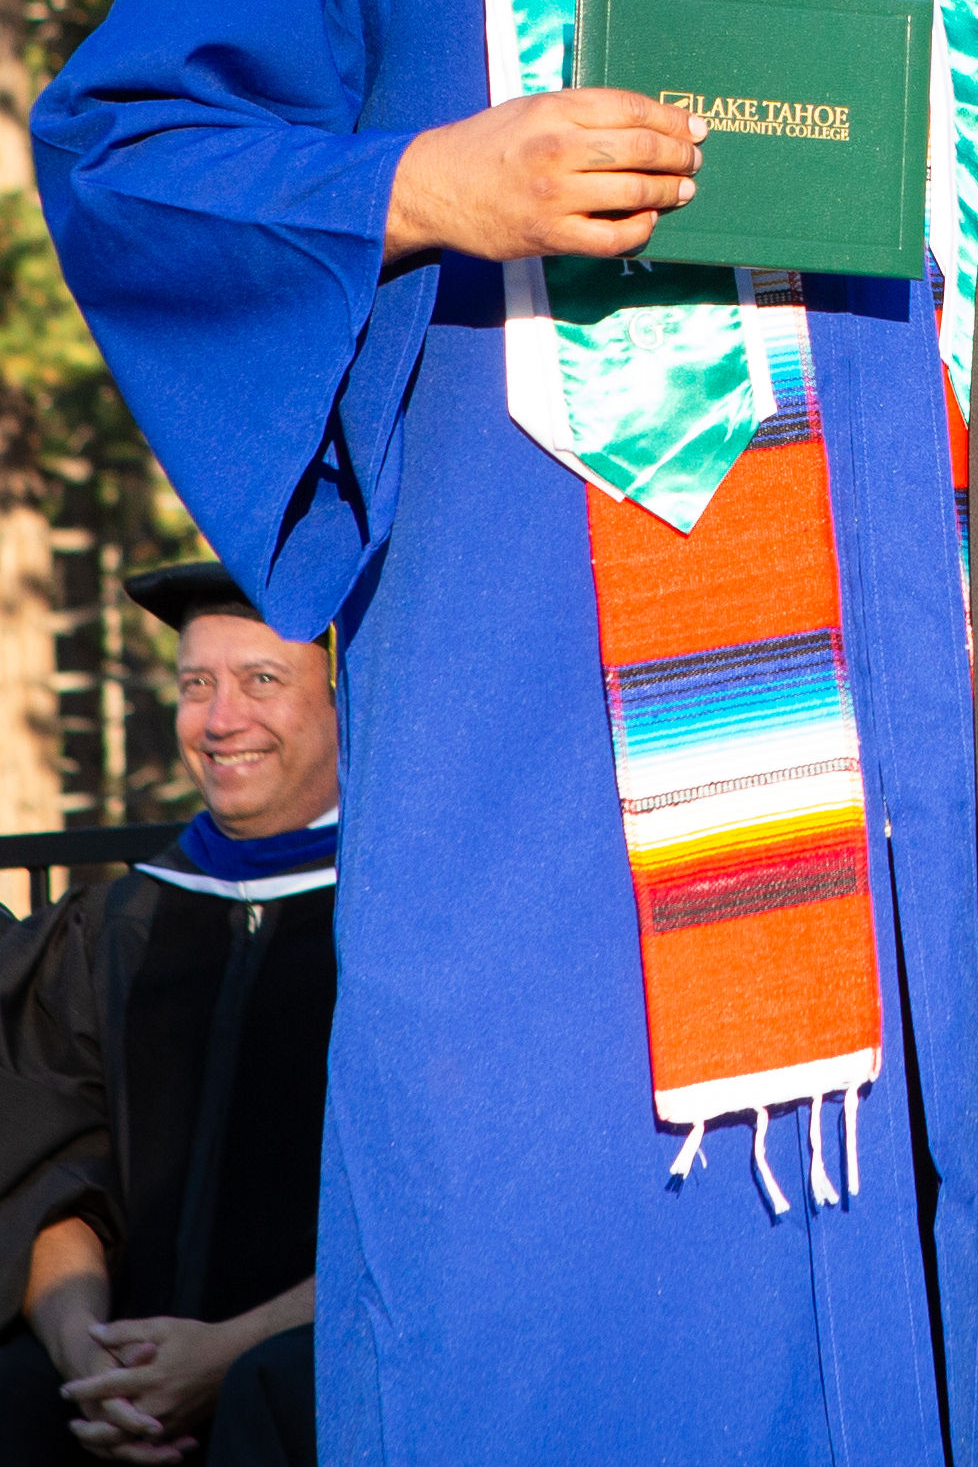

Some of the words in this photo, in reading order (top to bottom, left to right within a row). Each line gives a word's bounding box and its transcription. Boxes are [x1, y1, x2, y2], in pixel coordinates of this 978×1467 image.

[696, 95, 759, 121] LAKE
[762, 100, 850, 129] TAHOE
[703, 117, 784, 137] OMMUNITY
[785, 123, 850, 142] COLLEGE
